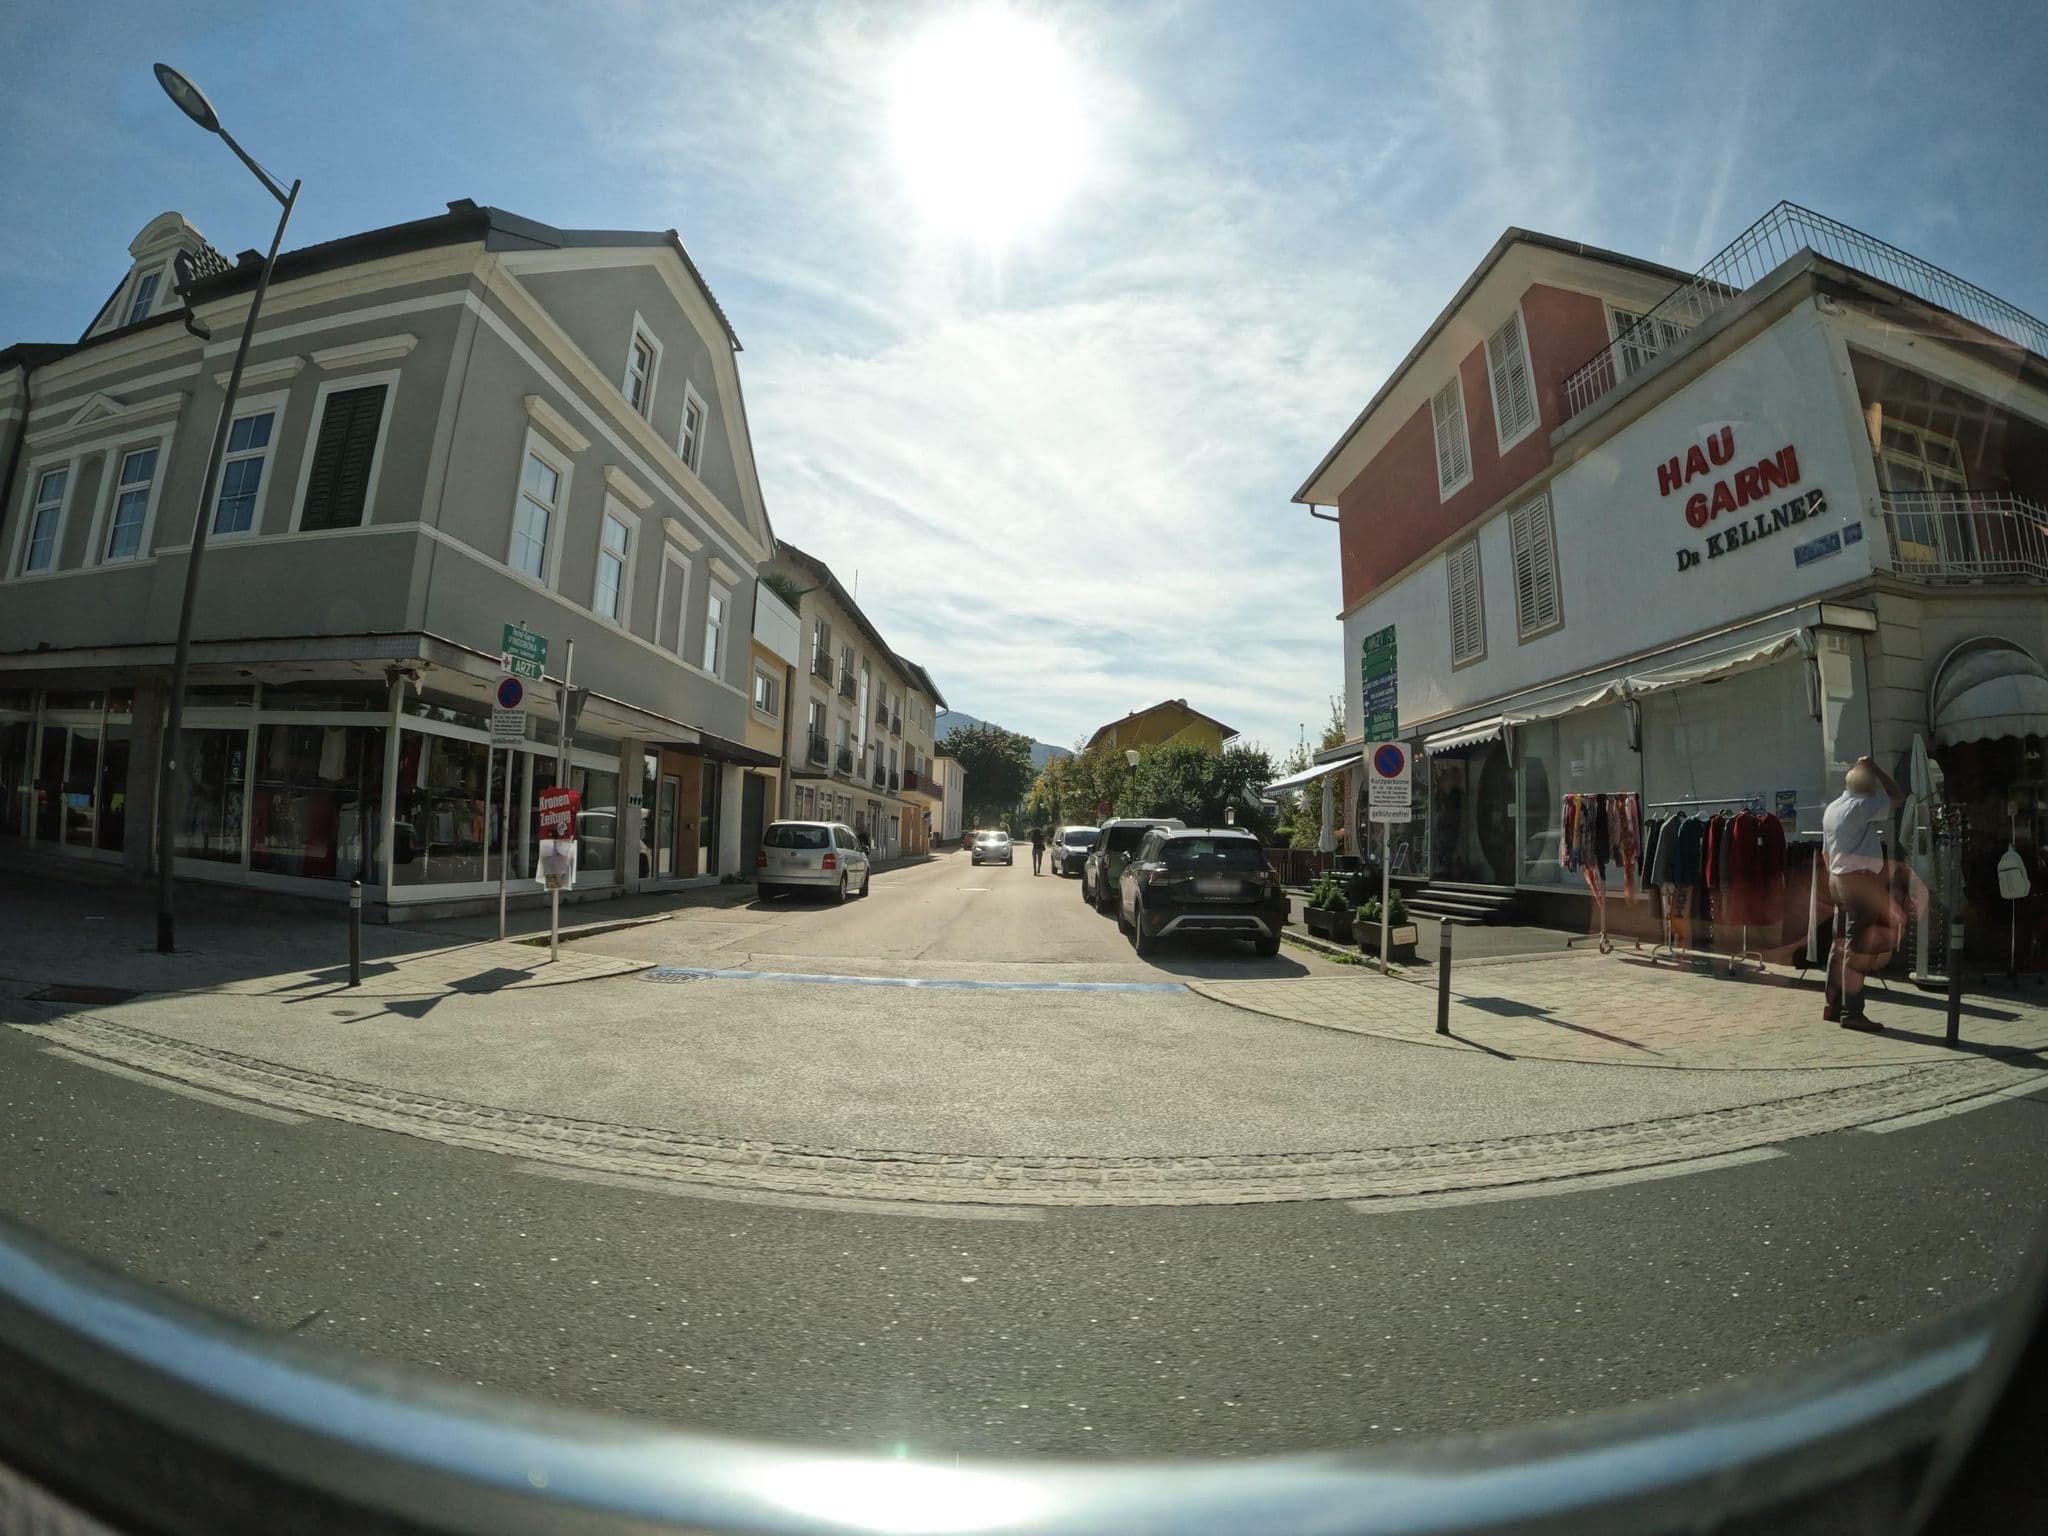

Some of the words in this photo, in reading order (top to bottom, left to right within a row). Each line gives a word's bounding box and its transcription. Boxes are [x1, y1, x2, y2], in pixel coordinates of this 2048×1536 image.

[1657, 426, 1735, 497] HAU
[1686, 445, 1800, 528] GARNI
[1705, 488, 1828, 559] KELLNER
[515, 660, 536, 677] ARZT
[539, 794, 569, 811] Kronen
[540, 810, 571, 827] Zeitung
